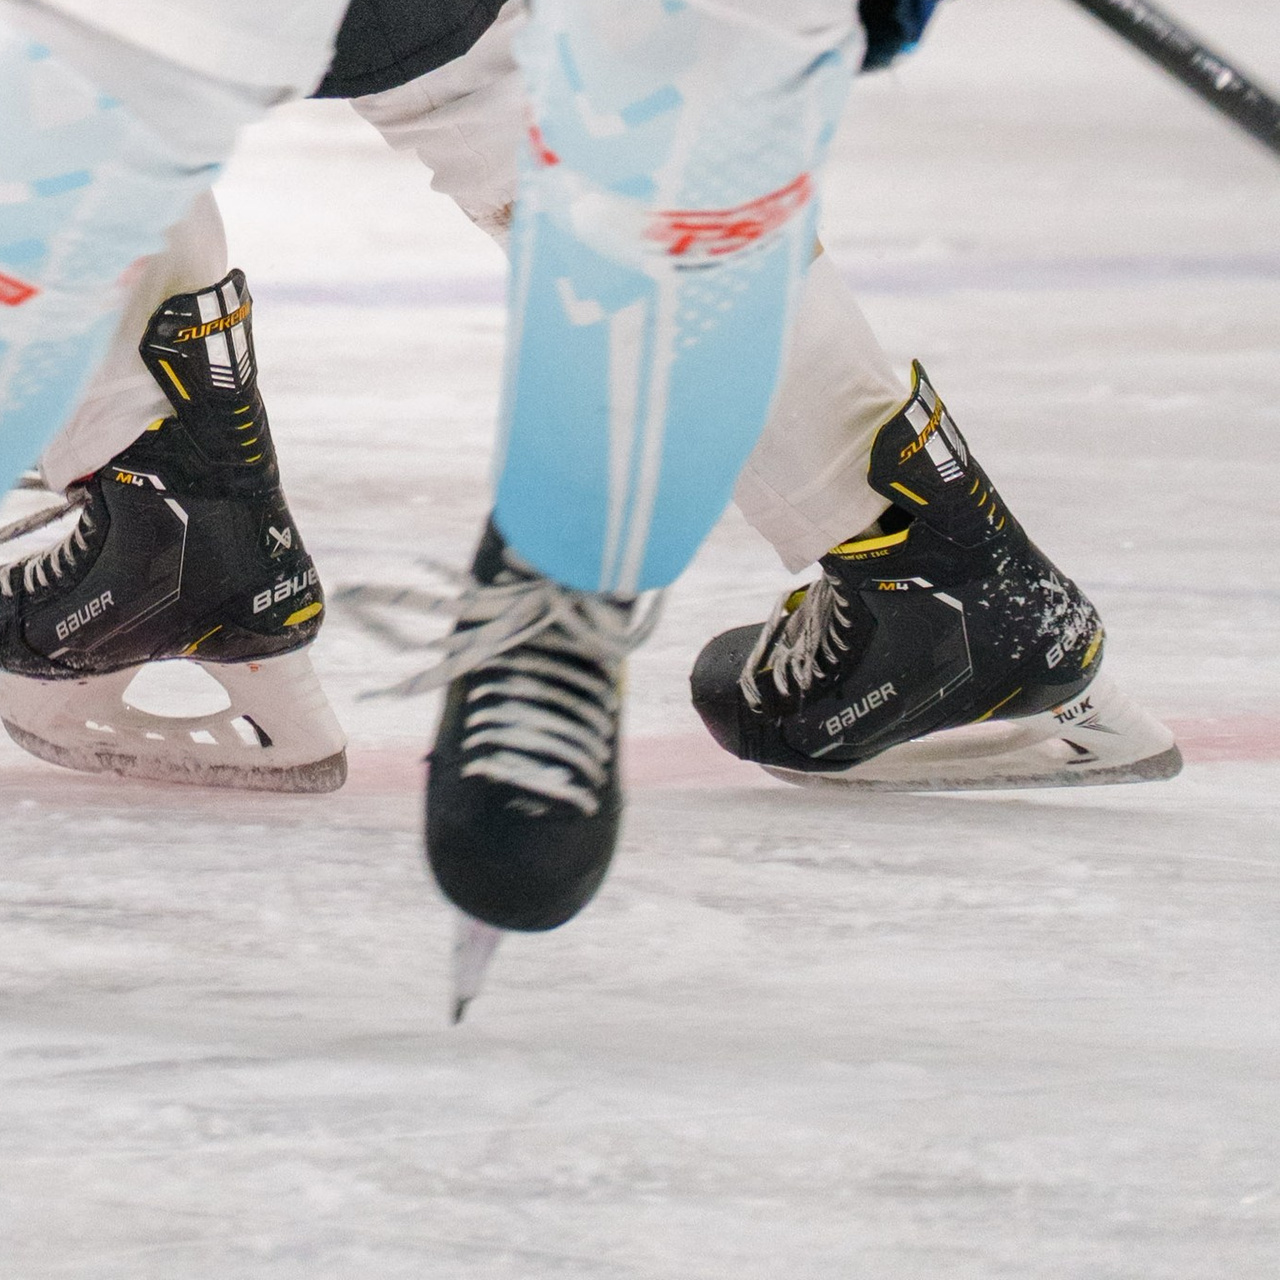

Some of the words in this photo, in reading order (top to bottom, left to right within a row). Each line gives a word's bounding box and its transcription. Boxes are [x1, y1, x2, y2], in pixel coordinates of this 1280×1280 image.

[172, 301, 251, 343] SUPREM
[116, 472, 144, 488] M4
[253, 566, 322, 615] BAUE
[877, 582, 909, 591] M4
[55, 590, 115, 641] BAUER
[825, 681, 898, 737] BAUER
